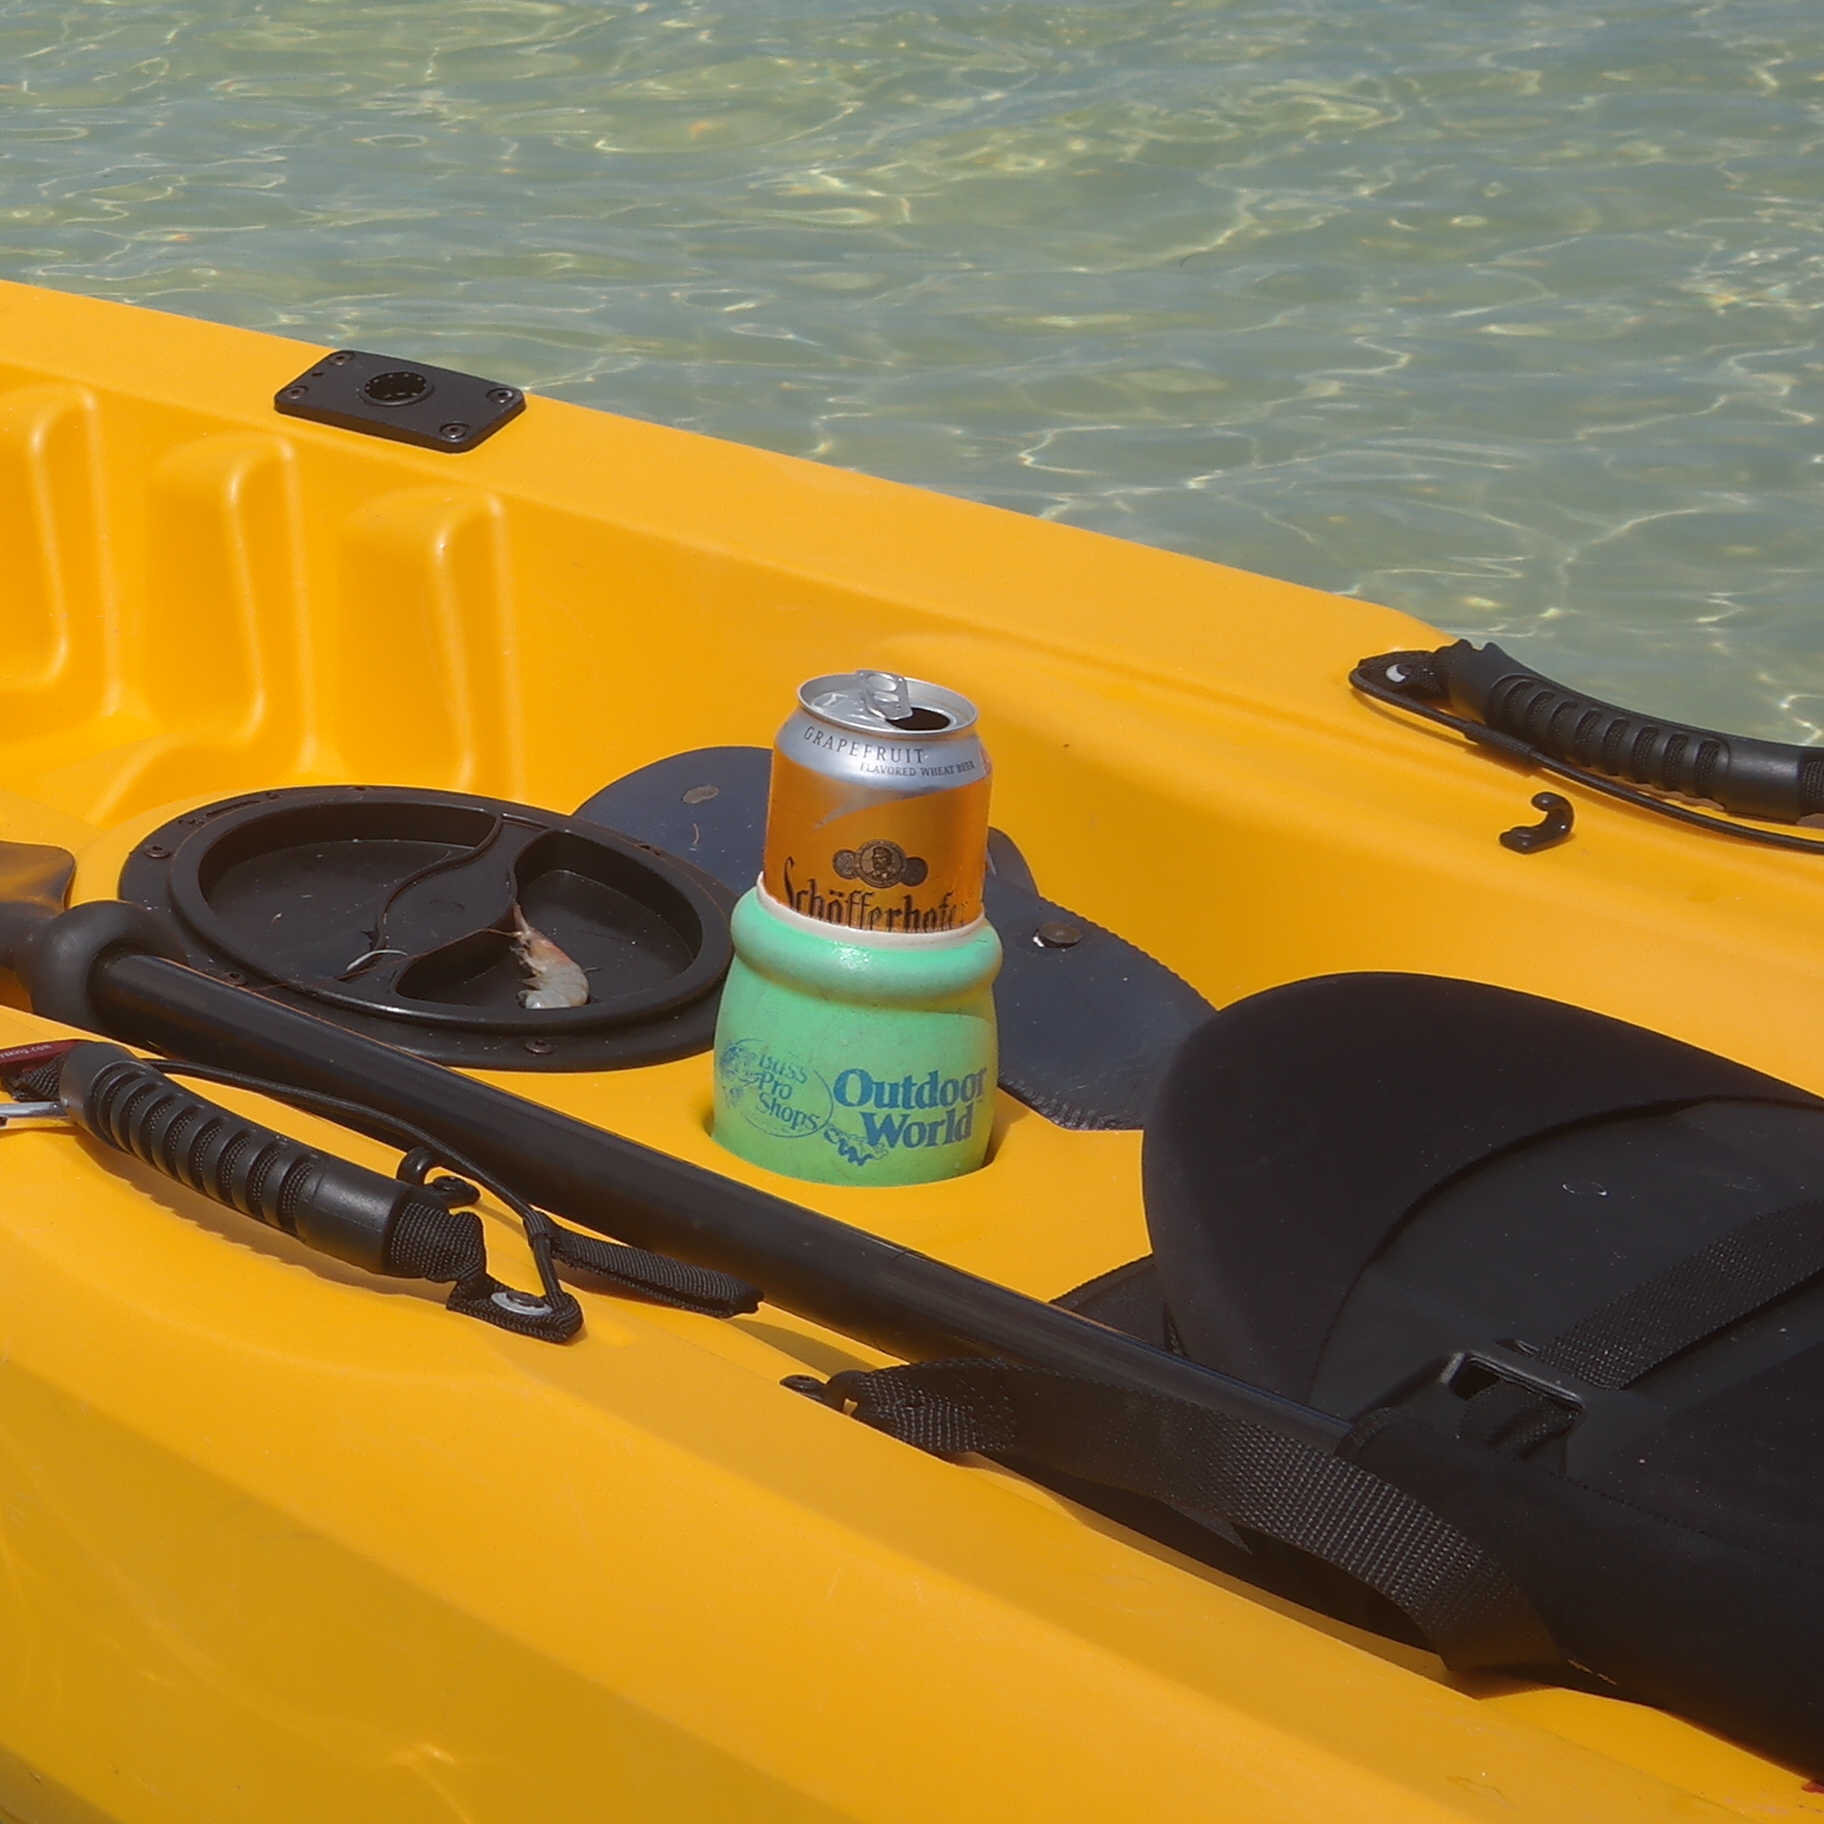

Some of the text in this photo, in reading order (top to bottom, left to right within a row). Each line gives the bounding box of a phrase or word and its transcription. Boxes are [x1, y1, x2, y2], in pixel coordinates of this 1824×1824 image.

[803, 726, 925, 763] GRAPEFRUIT
[860, 760, 975, 776] FLAVORED WHEAT BEER
[757, 1072, 792, 1099] Pro
[833, 1068, 987, 1110] Outdoor
[755, 1092, 820, 1130] Shops
[860, 1105, 972, 1149] World
